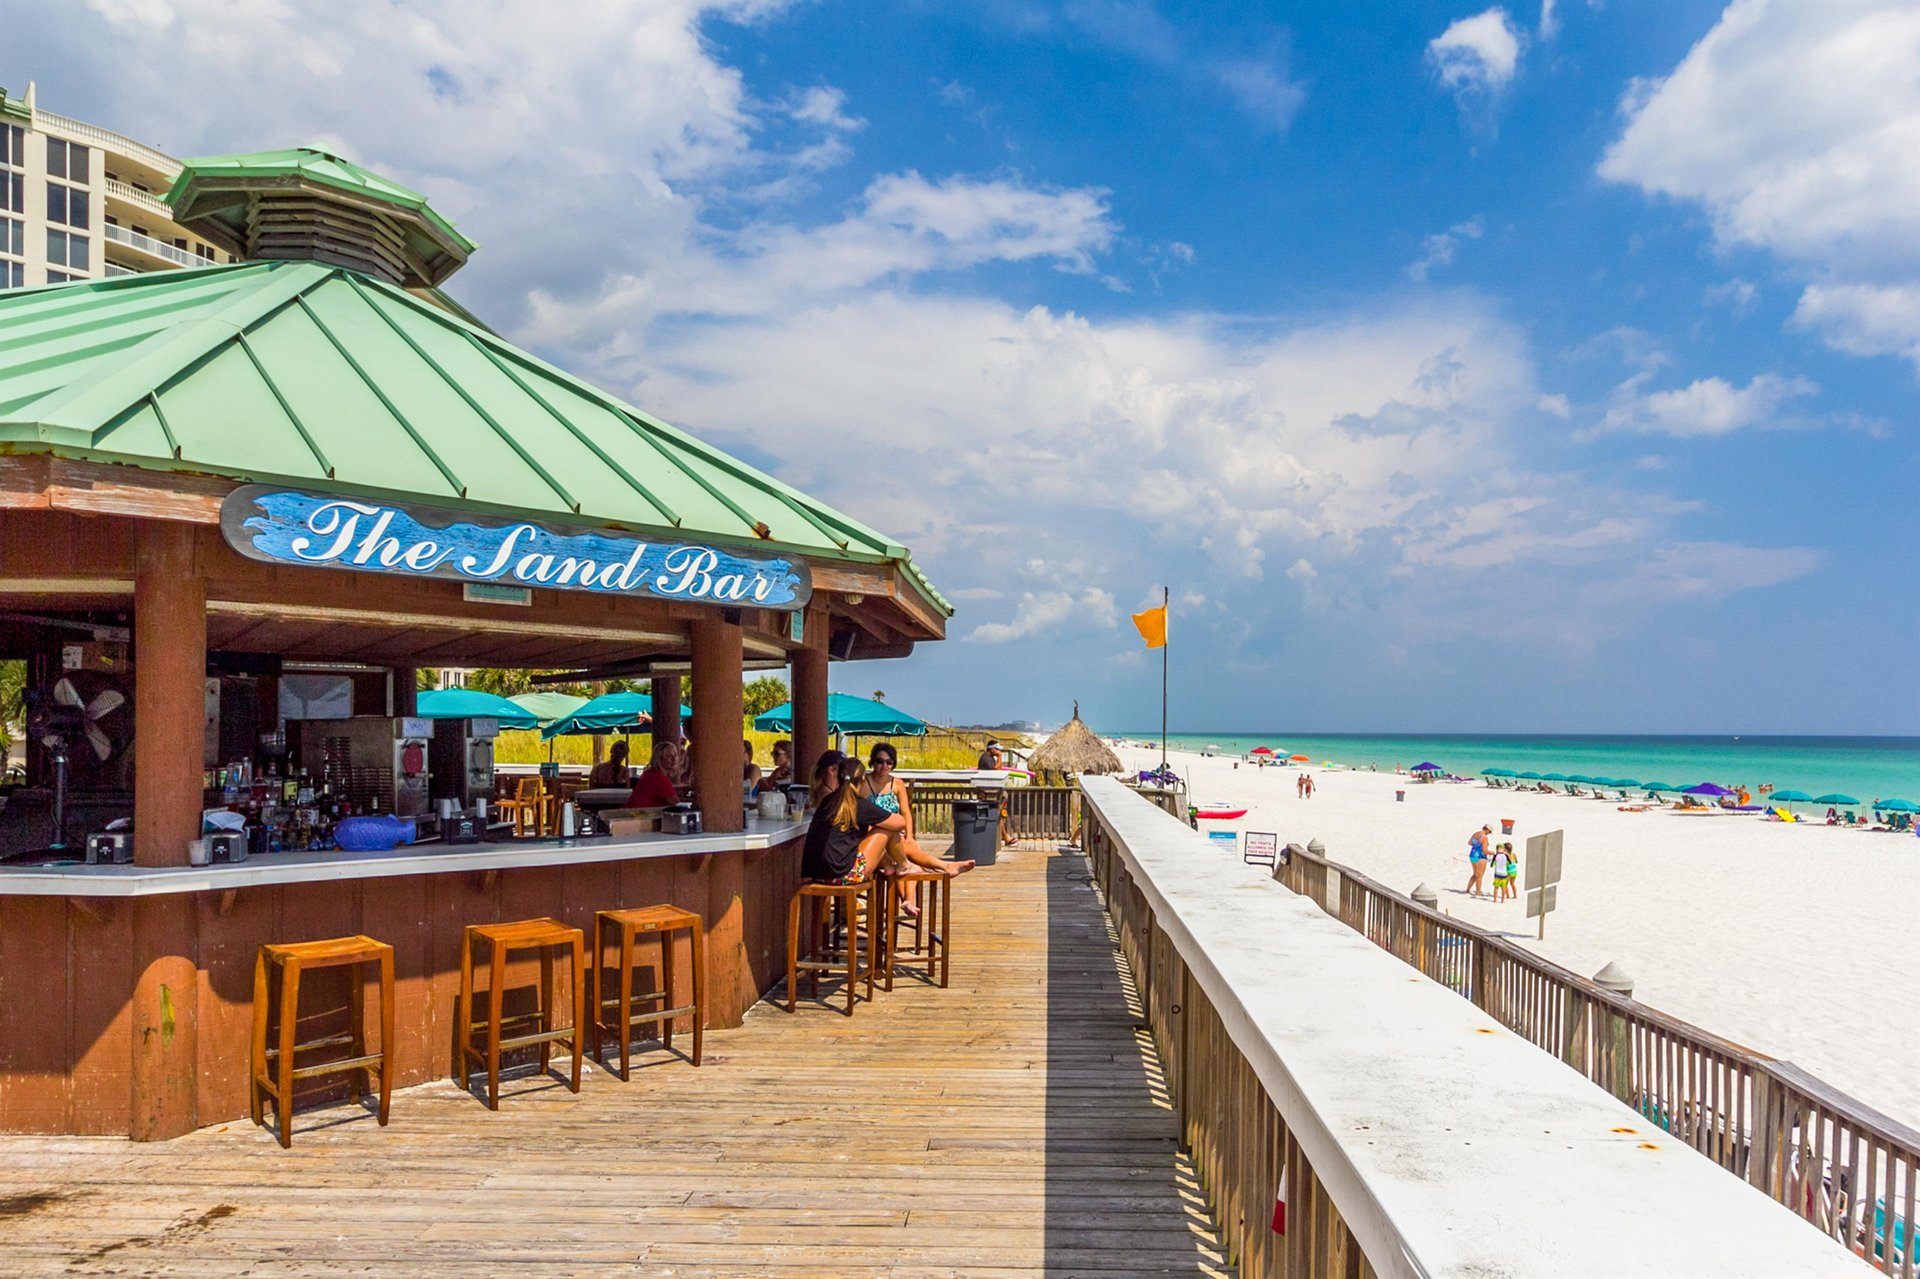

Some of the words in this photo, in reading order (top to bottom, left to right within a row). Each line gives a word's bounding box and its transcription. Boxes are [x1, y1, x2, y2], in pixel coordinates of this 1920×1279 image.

[291, 501, 455, 570] The
[462, 525, 650, 590] Sand
[656, 546, 777, 601] Bar
